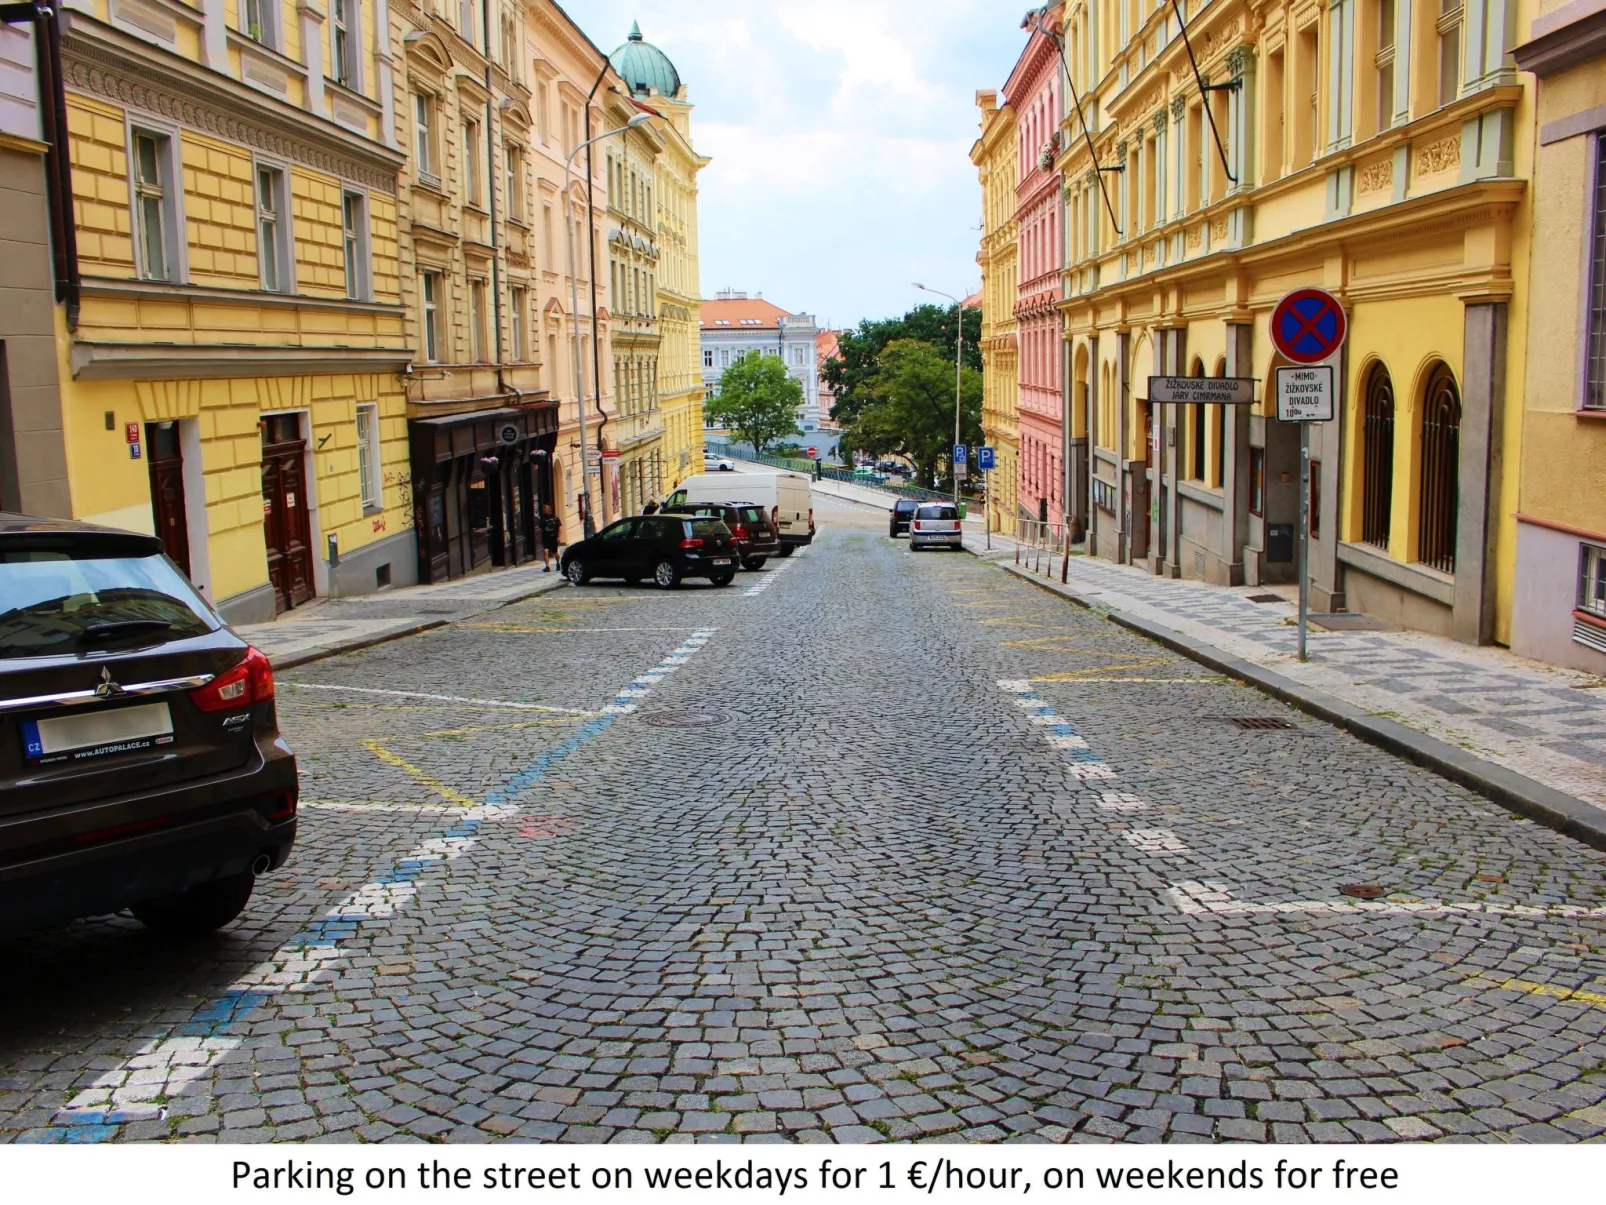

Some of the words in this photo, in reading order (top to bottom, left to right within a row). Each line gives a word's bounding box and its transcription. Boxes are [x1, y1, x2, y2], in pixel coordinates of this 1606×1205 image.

[1295, 371, 1315, 381] MIMO
[1208, 381, 1239, 391] DIVADLO
[1285, 381, 1324, 394] ŽIŽKOVSKÉ
[1172, 389, 1190, 400] JÁRY
[1192, 392, 1232, 401] CIMRMANA
[1289, 396, 1319, 406] DIVADLO
[955, 447, 964, 458] P
[981, 450, 991, 463] P
[222, 713, 250, 726] ASX
[28, 742, 41, 753] CZ
[74, 741, 150, 760] www.AUTOPALACE.cz
